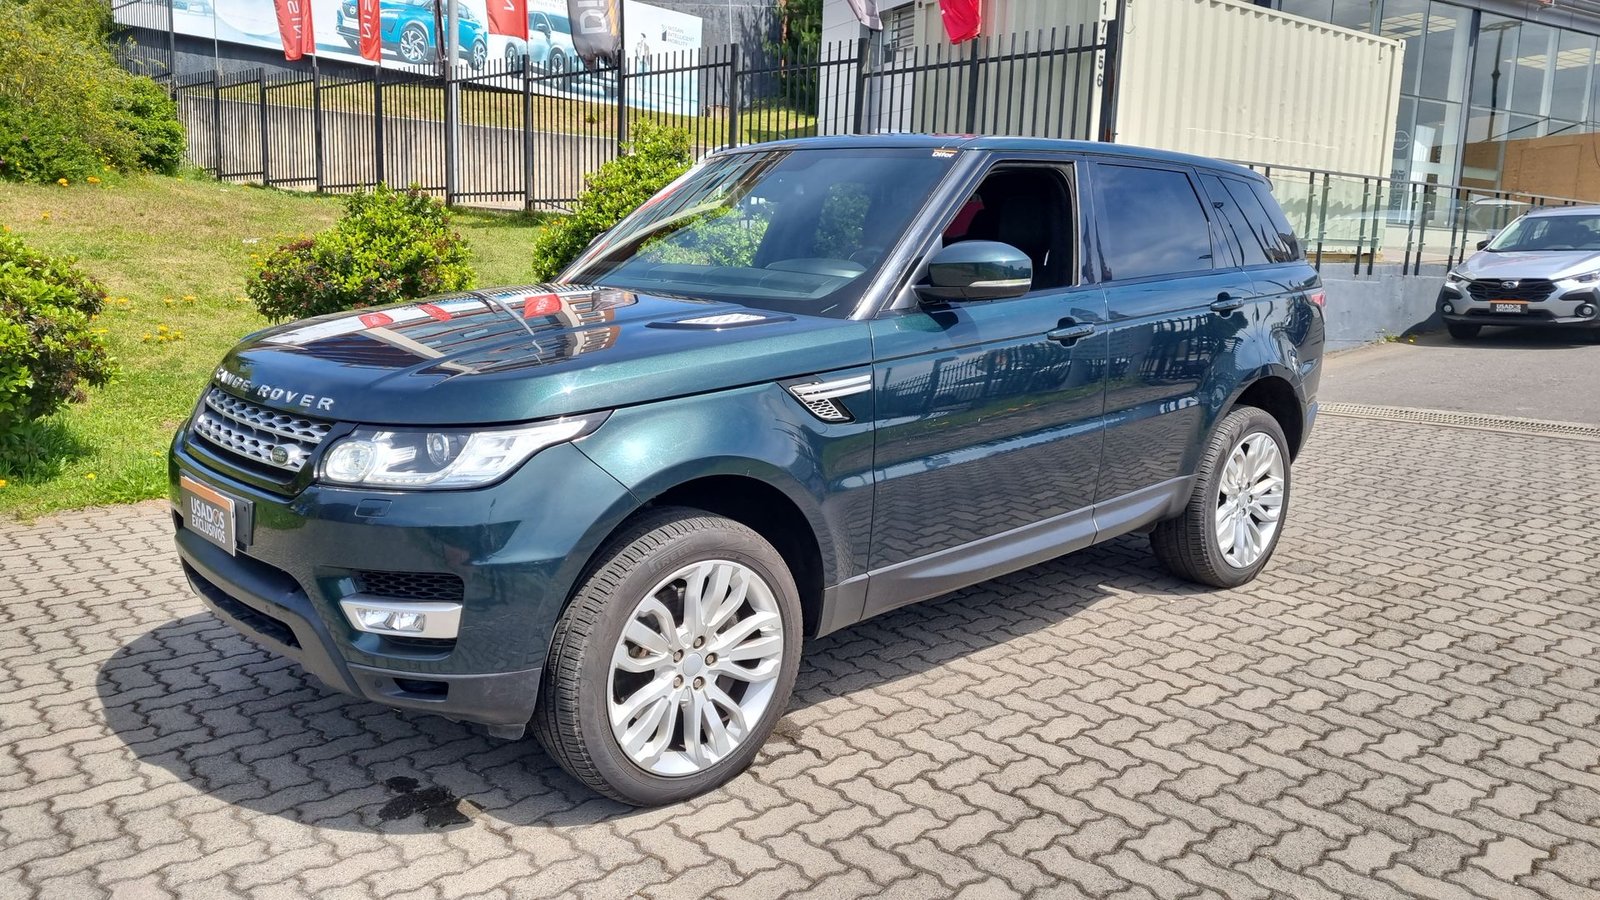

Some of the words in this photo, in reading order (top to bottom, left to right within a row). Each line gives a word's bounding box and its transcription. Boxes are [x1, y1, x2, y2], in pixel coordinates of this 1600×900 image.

[257, 384, 335, 411] ROVER
[190, 496, 225, 530] USADOS
[191, 514, 226, 544] EXCLUSIVOS
